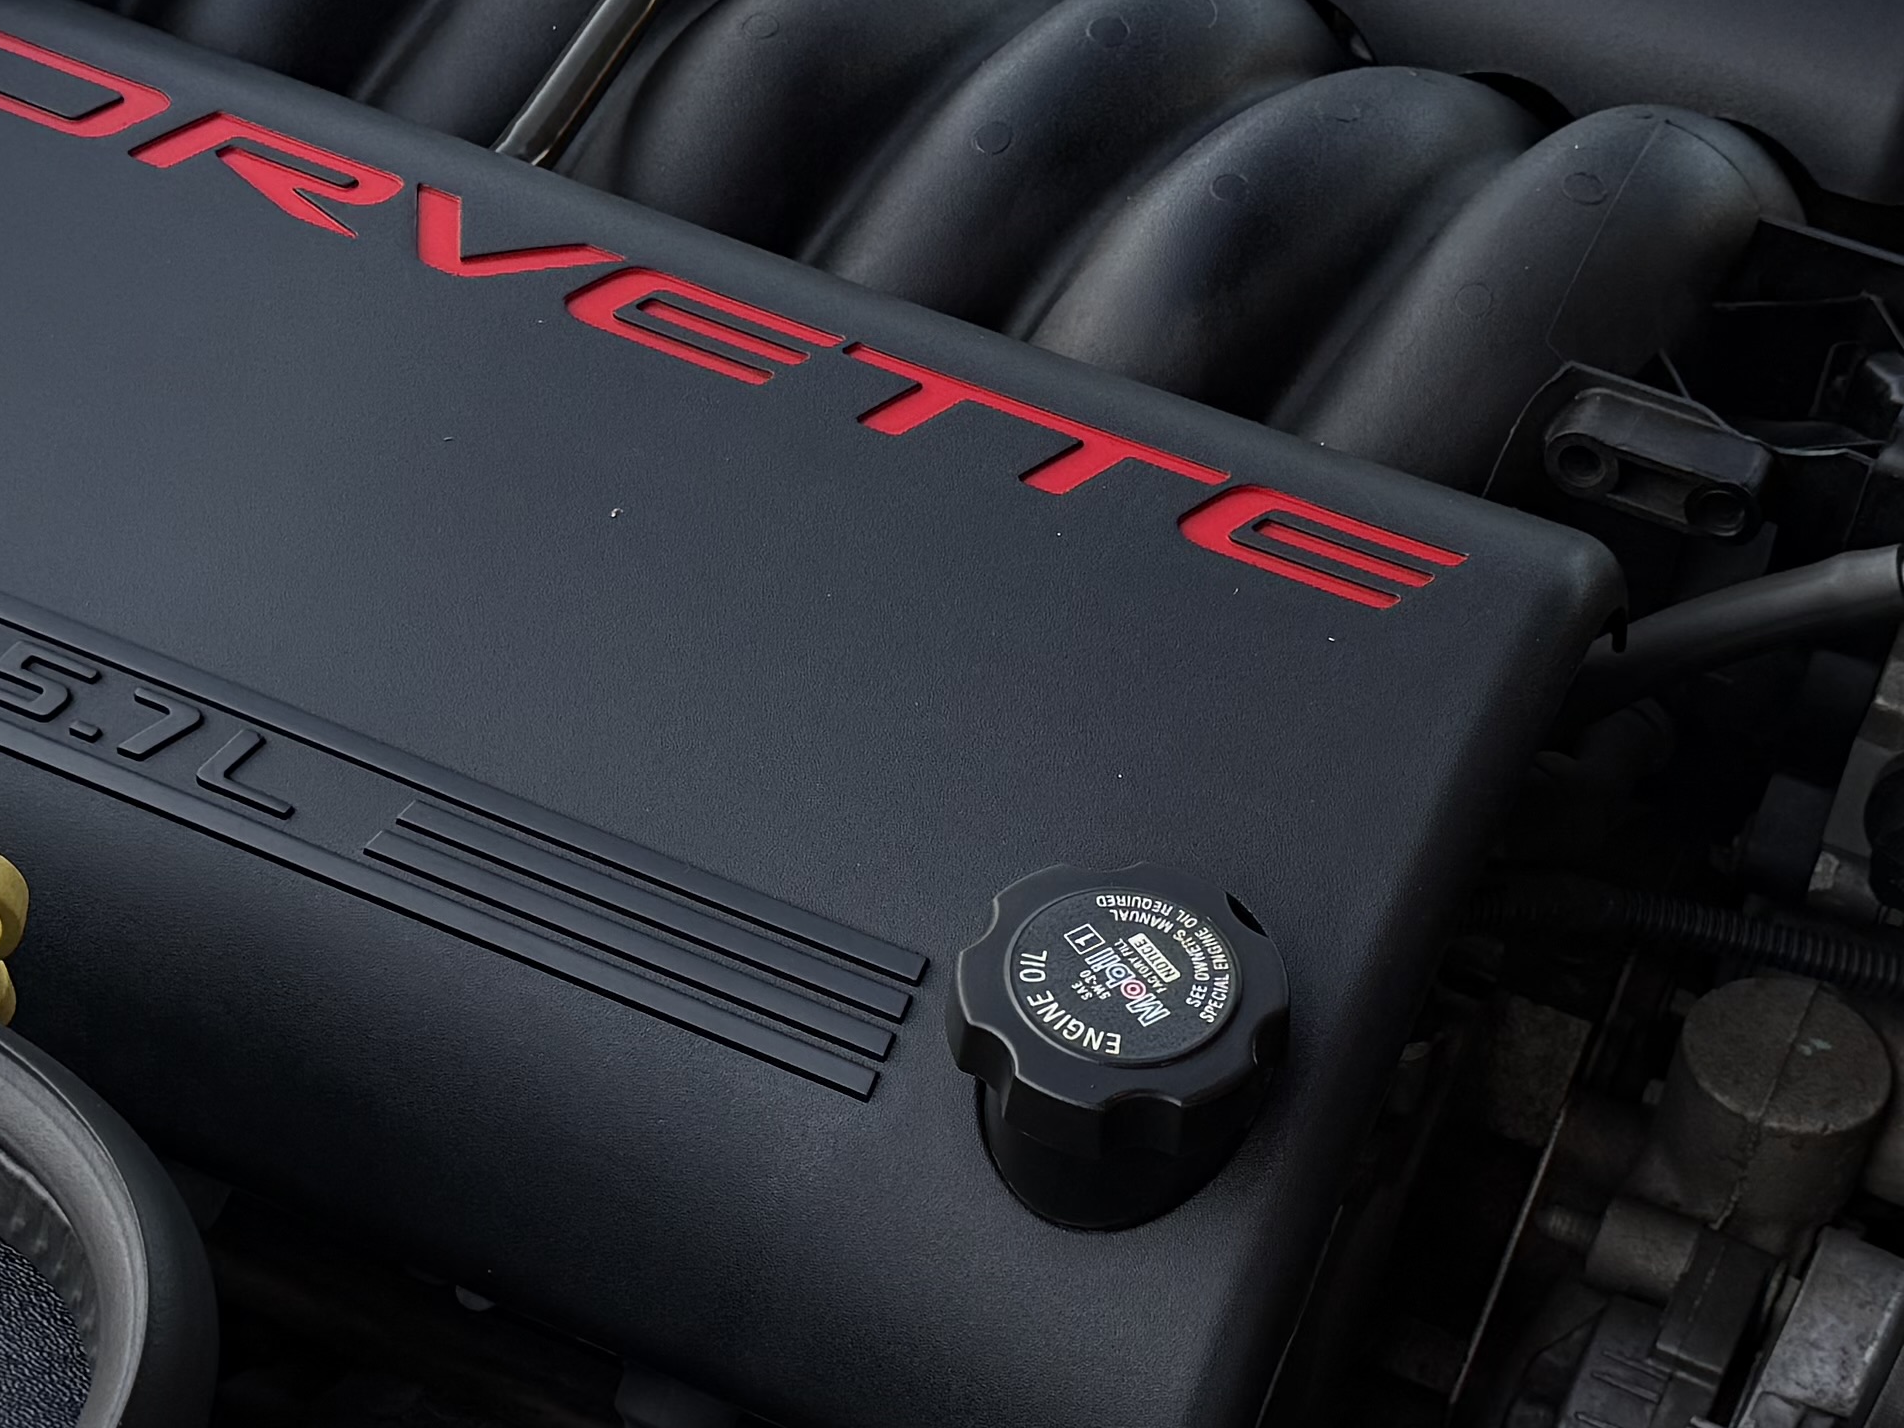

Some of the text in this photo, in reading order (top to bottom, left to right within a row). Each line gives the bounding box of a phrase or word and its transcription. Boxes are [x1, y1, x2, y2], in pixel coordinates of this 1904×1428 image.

[1109, 908, 1174, 934] MANUAL
[1095, 894, 1231, 1024] SPECIAL ENGINE OIL REQUIRED
[1133, 938, 1178, 980] NOTICE
[1018, 949, 1123, 1056] ENGINE OIL
[1070, 980, 1094, 1001] SAE
[1084, 945, 1172, 1028] Mobil
[1186, 982, 1210, 1008] SEE
